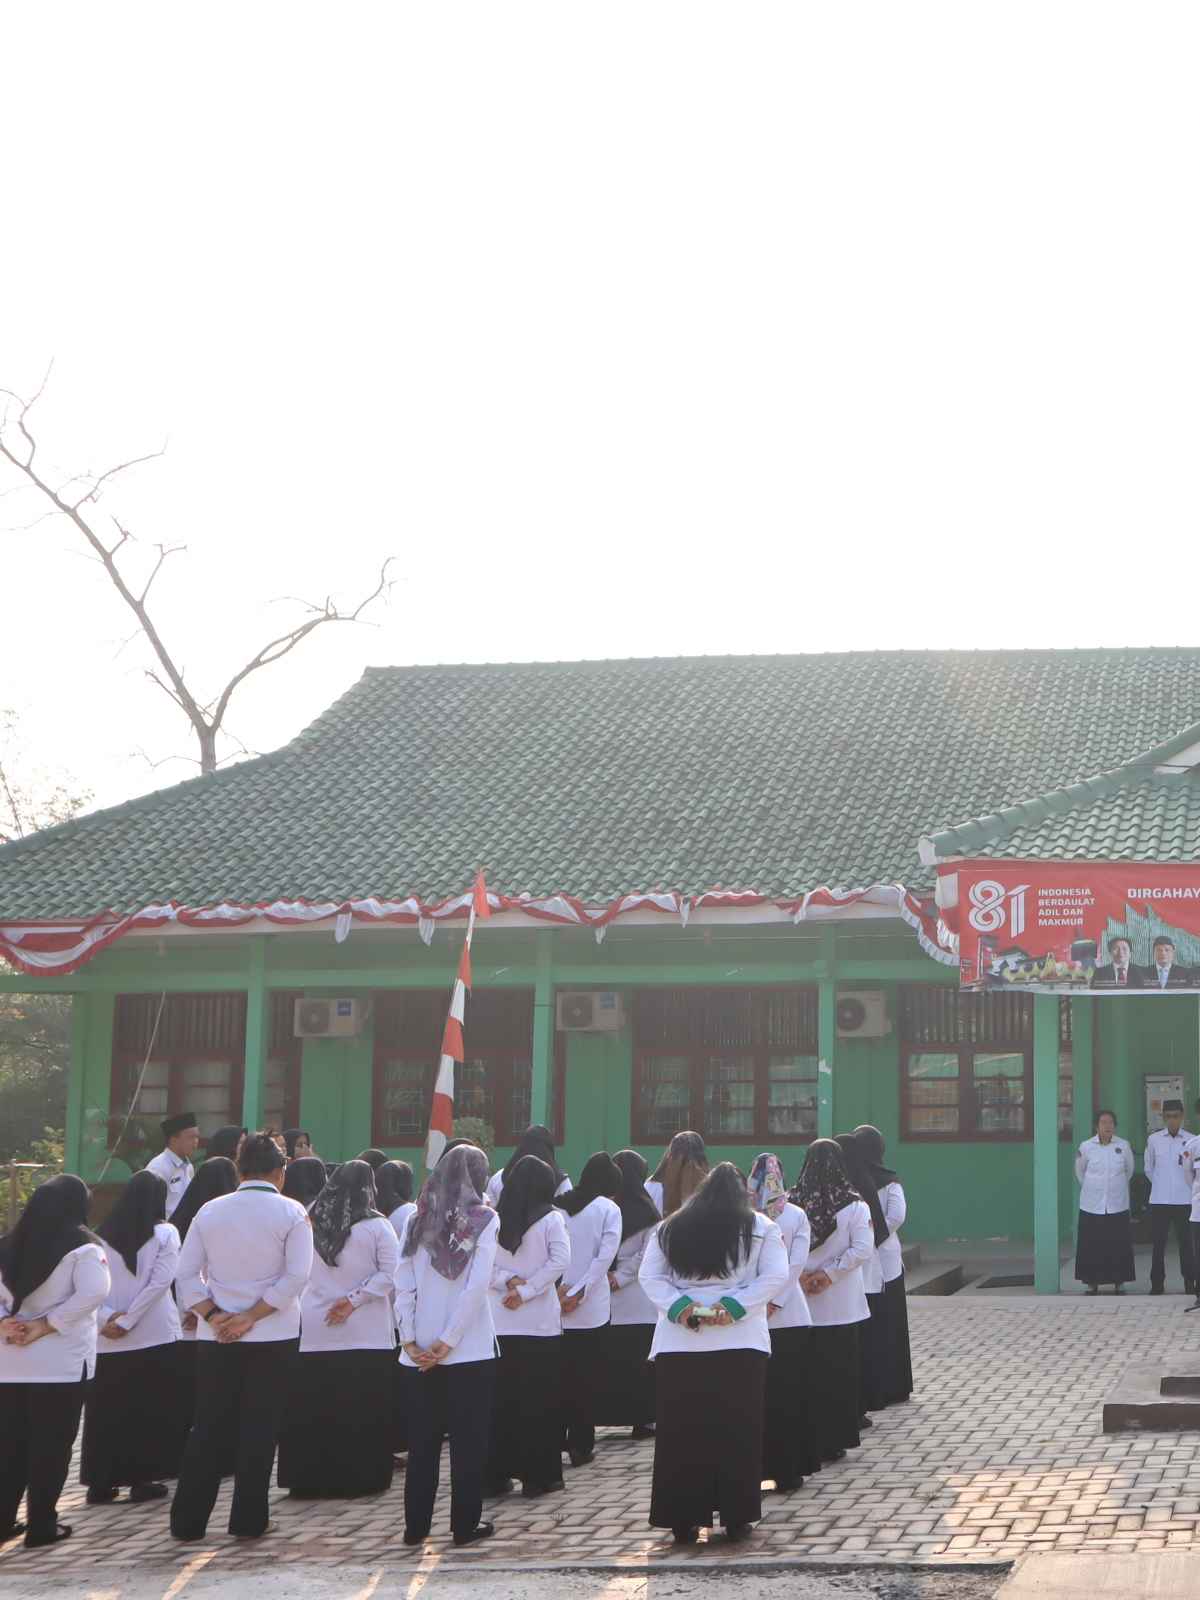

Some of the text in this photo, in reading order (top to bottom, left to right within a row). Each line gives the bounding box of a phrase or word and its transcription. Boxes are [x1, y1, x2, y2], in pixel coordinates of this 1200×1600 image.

[1038, 888, 1092, 897] INDONESIA
[1038, 897, 1096, 906] BERDAULAT
[968, 879, 1031, 938] 81
[1038, 907, 1084, 916] ADIL DAN
[1038, 918, 1084, 927] MAKMUR
